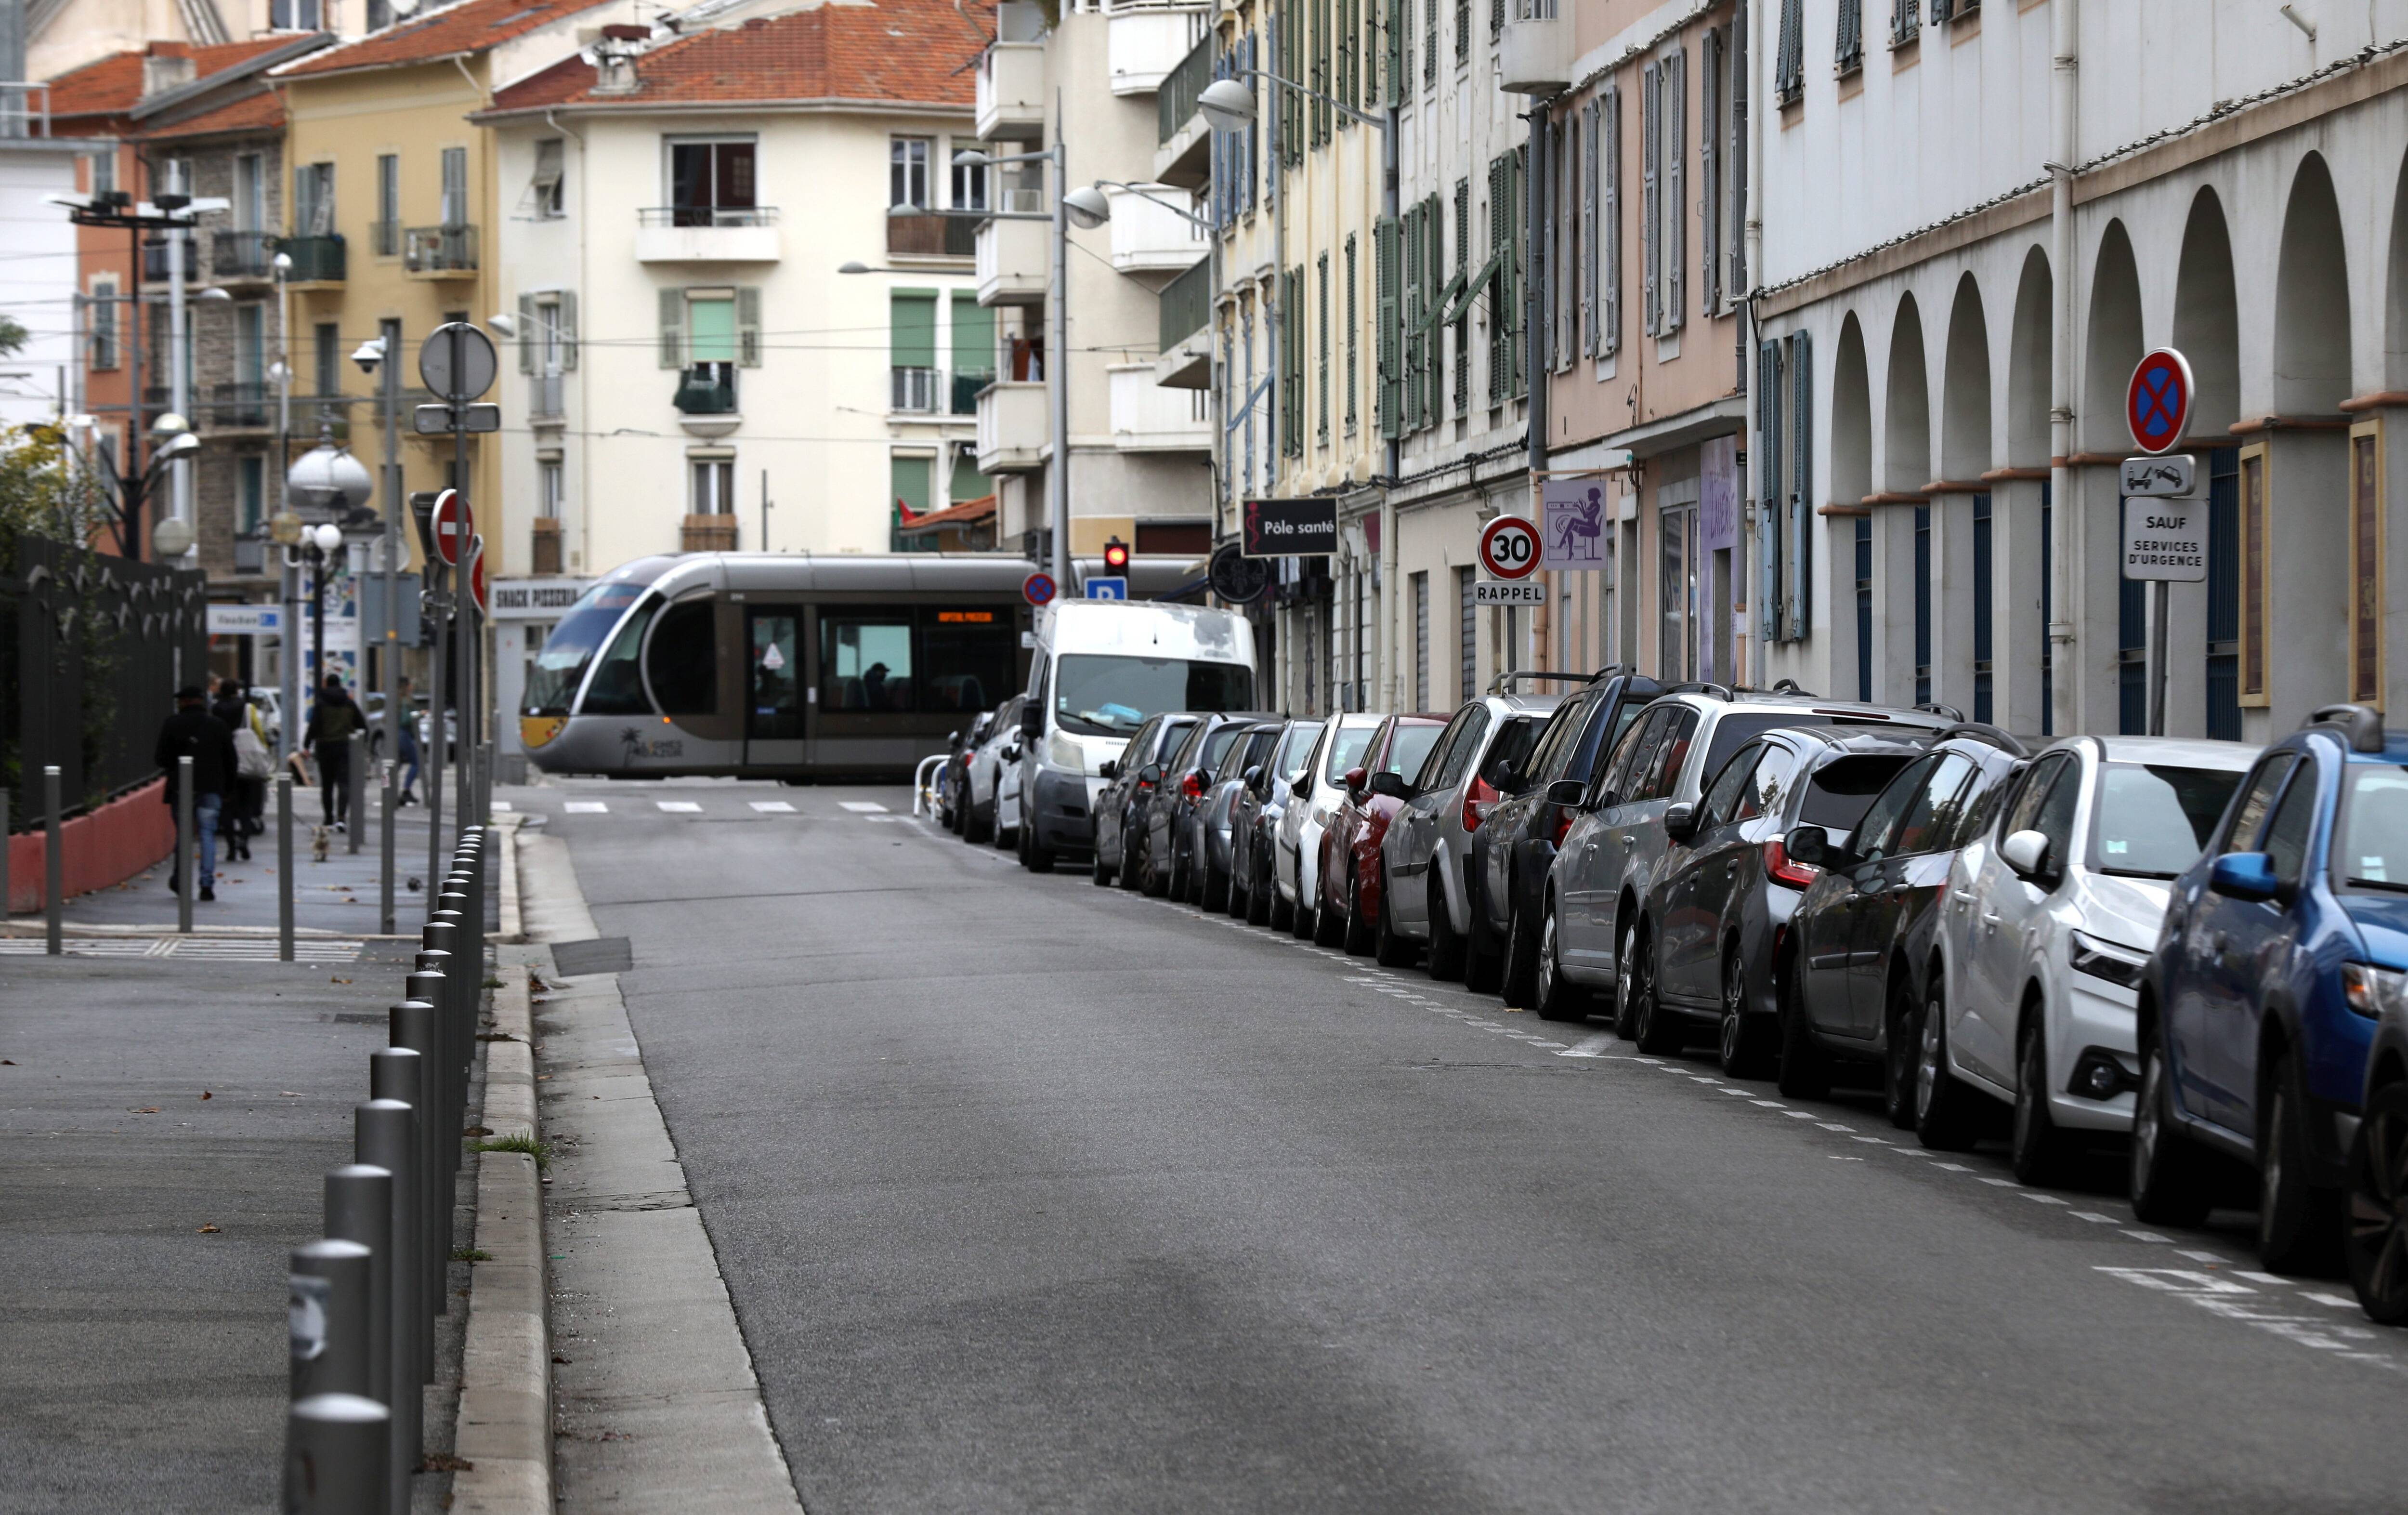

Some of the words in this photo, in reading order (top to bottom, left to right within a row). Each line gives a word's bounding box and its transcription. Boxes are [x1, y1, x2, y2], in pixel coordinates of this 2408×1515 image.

[1264, 519, 1294, 535] Pôle
[1297, 520, 1335, 533] santé
[2146, 516, 2186, 529] SAUF
[1493, 535, 1531, 562] 30
[2133, 540, 2198, 552] SERVICES
[2129, 553, 2202, 566] D'URGENCE
[1478, 587, 1542, 600] RAPPEL
